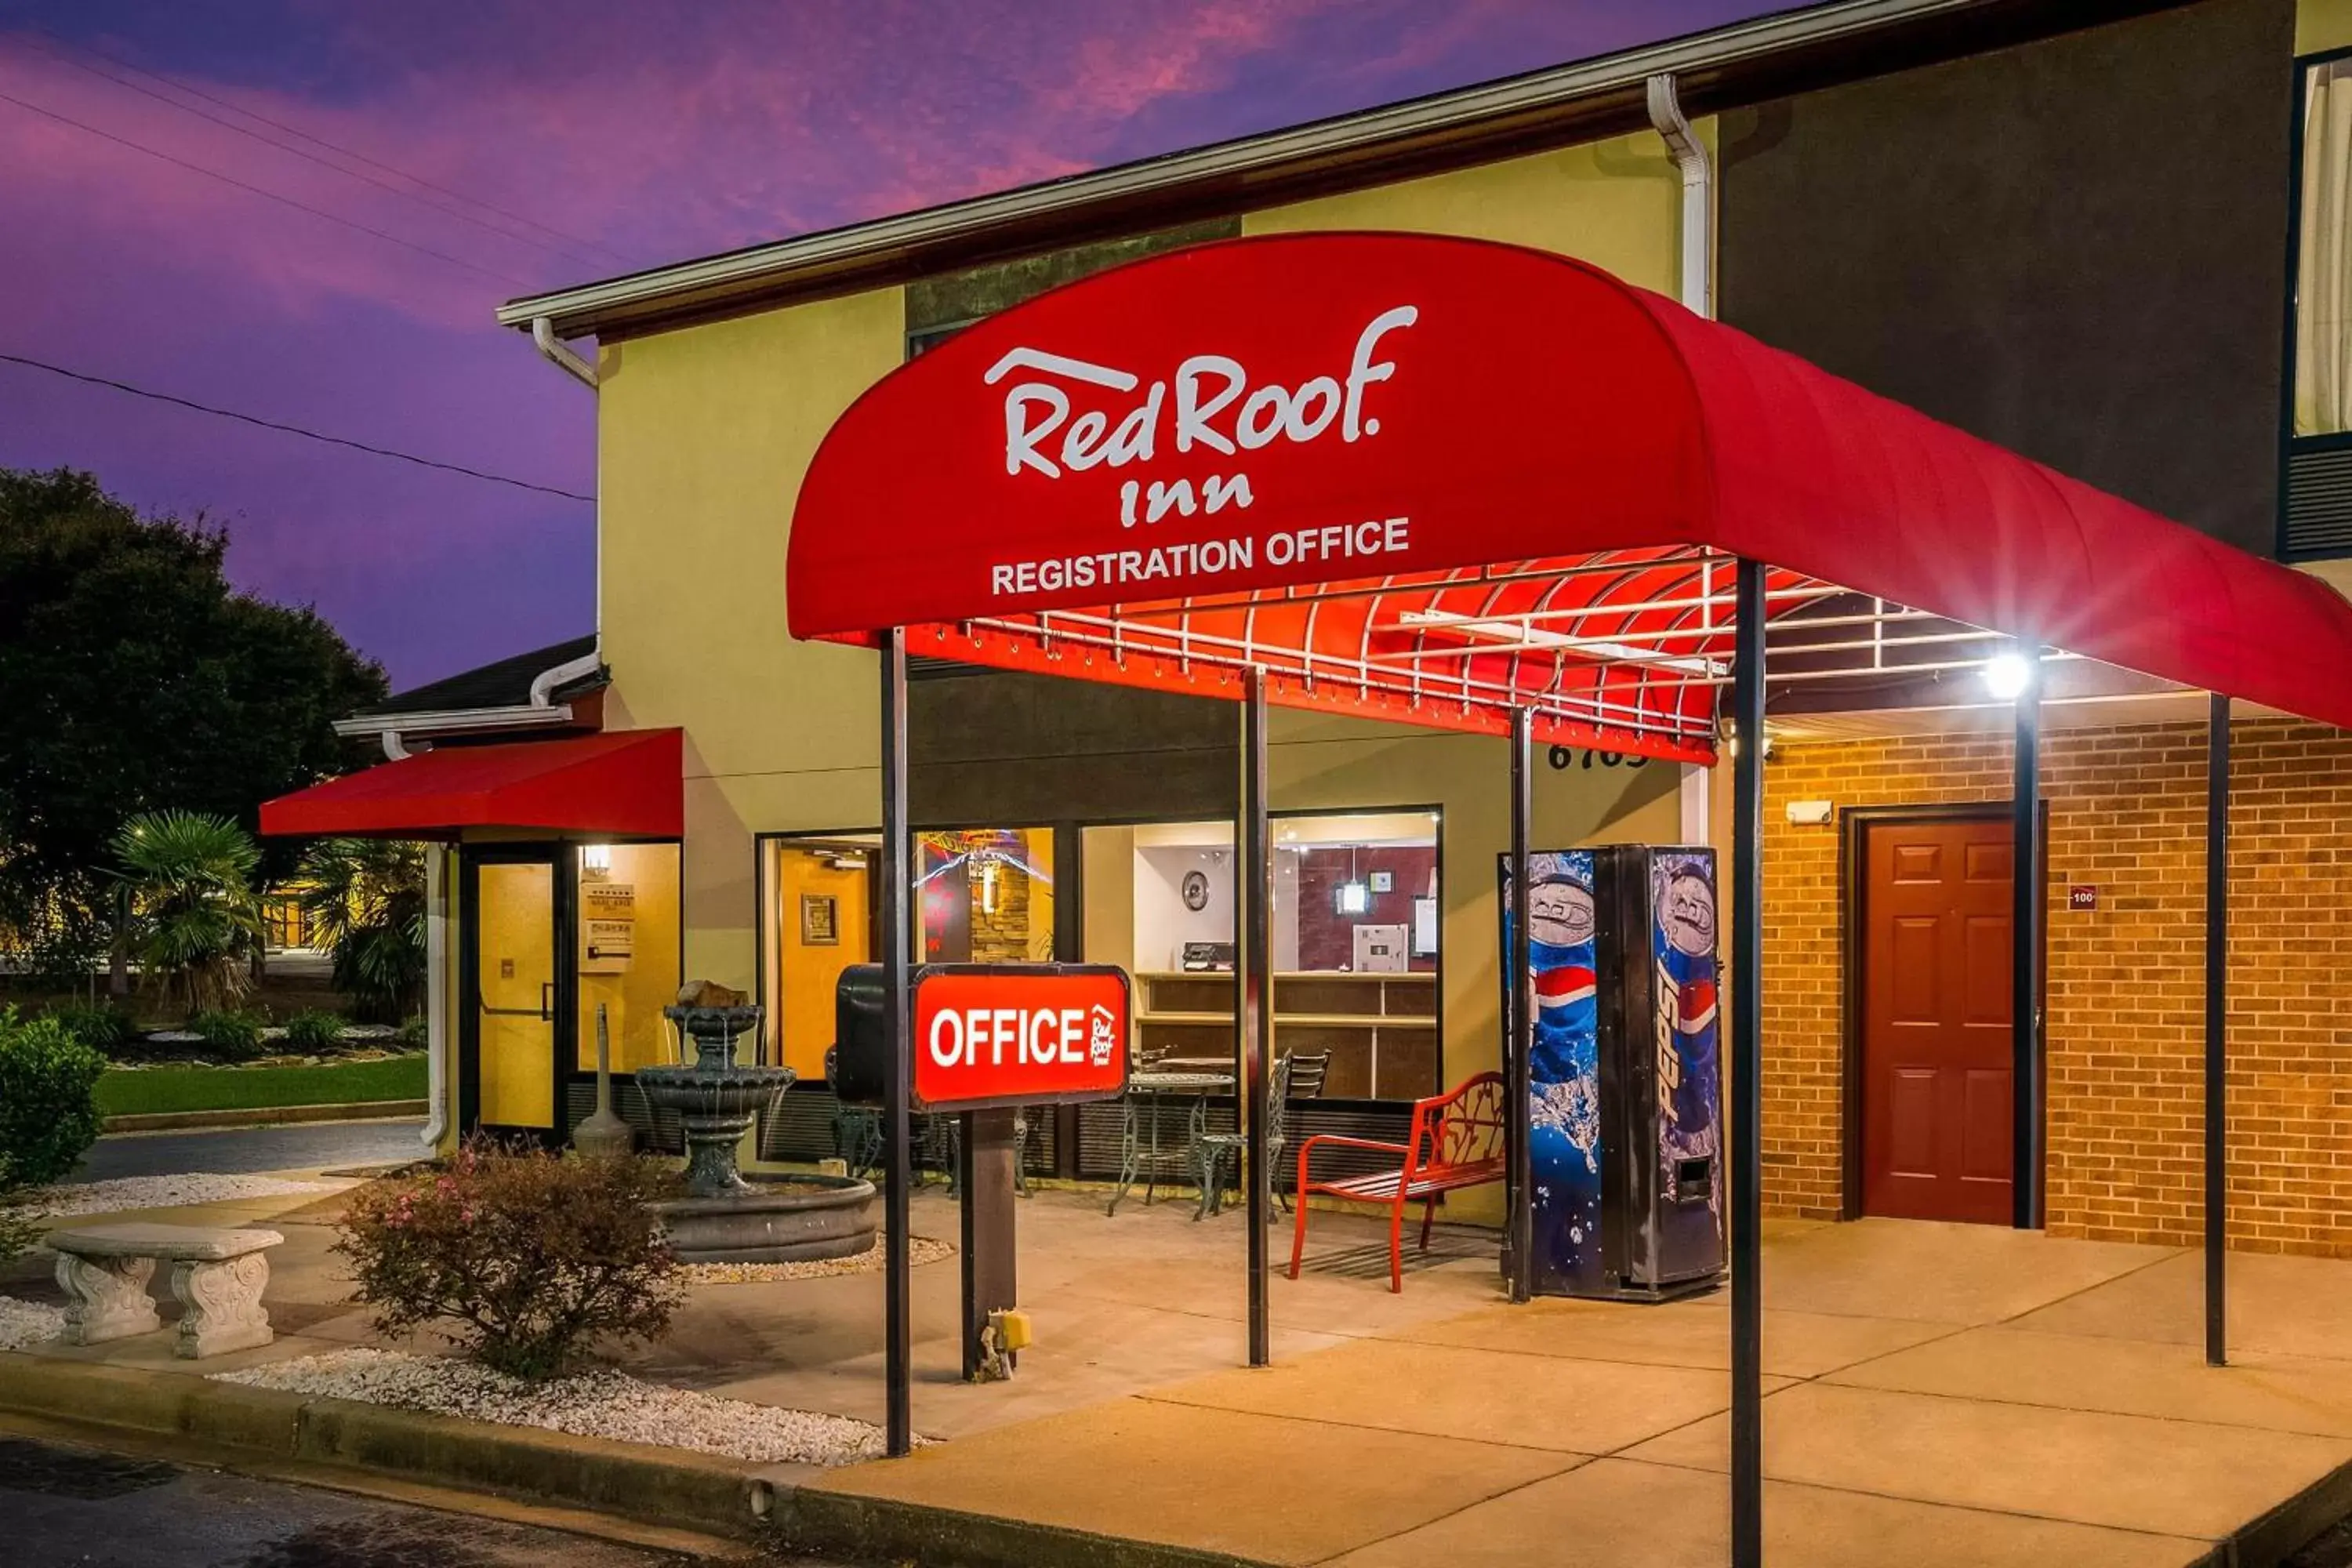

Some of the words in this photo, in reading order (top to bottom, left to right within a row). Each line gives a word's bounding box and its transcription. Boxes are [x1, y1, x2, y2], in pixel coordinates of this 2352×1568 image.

[1006, 381, 1165, 478] Red
[992, 536, 1253, 595] REGISTRATION
[1266, 517, 1409, 565] OFFICE
[2074, 893, 2092, 902] 100
[930, 1008, 1084, 1067] OFFICE
[1657, 957, 1679, 1122] PEPSI
